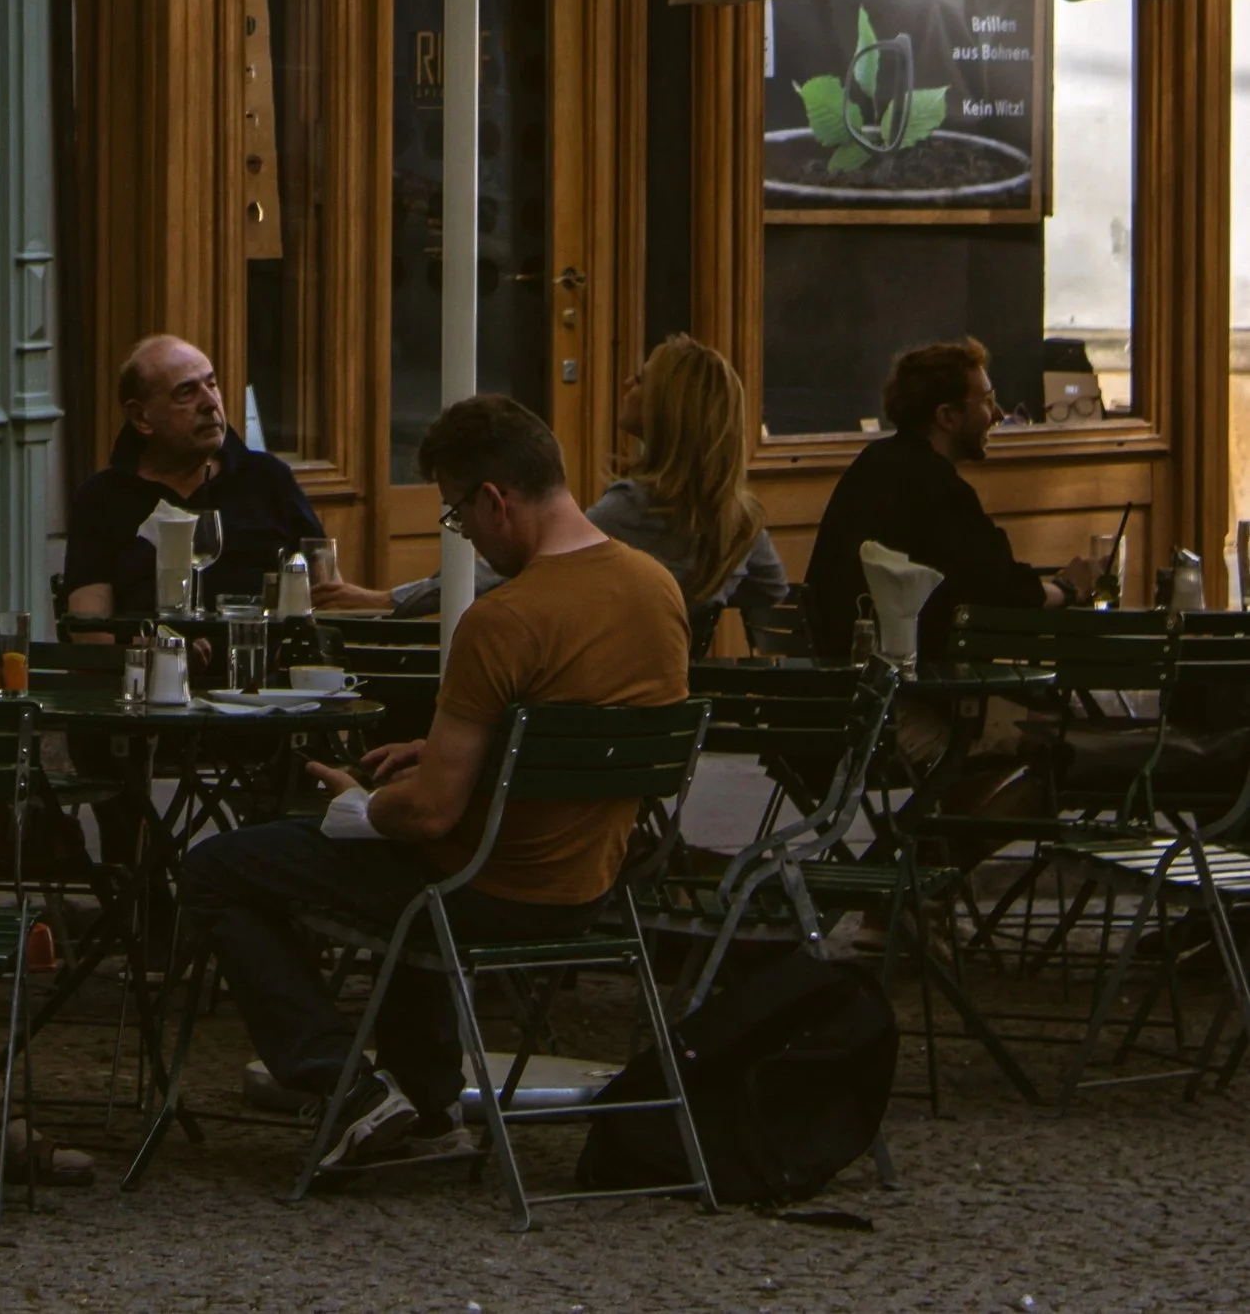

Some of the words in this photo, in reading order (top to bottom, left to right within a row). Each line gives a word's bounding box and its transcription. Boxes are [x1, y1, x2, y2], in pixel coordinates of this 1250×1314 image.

[972, 16, 1017, 32] Brillen
[952, 46, 978, 60] aus
[962, 99, 993, 116] Kein
[995, 99, 1025, 116] Witz!
